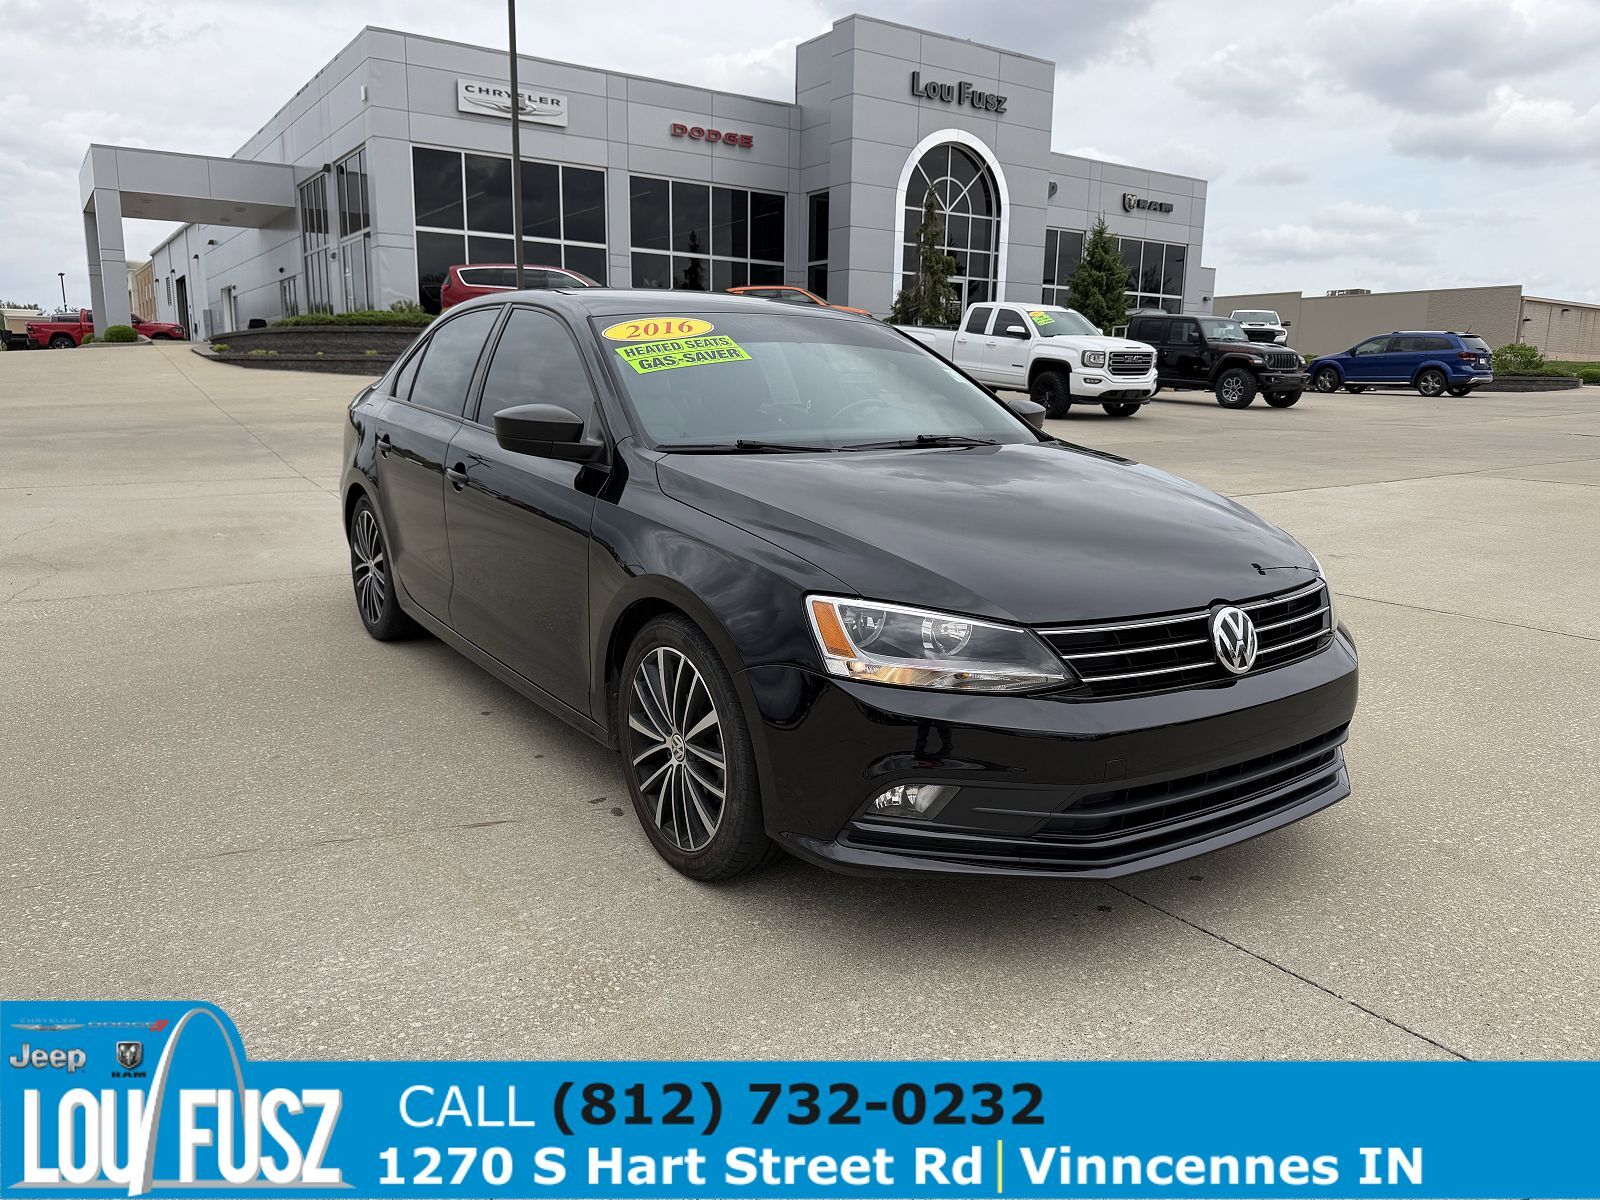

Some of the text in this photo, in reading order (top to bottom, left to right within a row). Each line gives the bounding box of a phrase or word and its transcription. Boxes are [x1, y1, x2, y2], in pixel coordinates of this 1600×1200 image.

[465, 85, 560, 106] CHRYSLER
[912, 71, 1007, 113] Lou Fusz
[671, 123, 753, 148] DODGE
[1137, 199, 1173, 213] RAM
[626, 320, 694, 339] 2016
[624, 337, 732, 357] HEATED SEATS
[639, 348, 743, 370] GAS-SAVER
